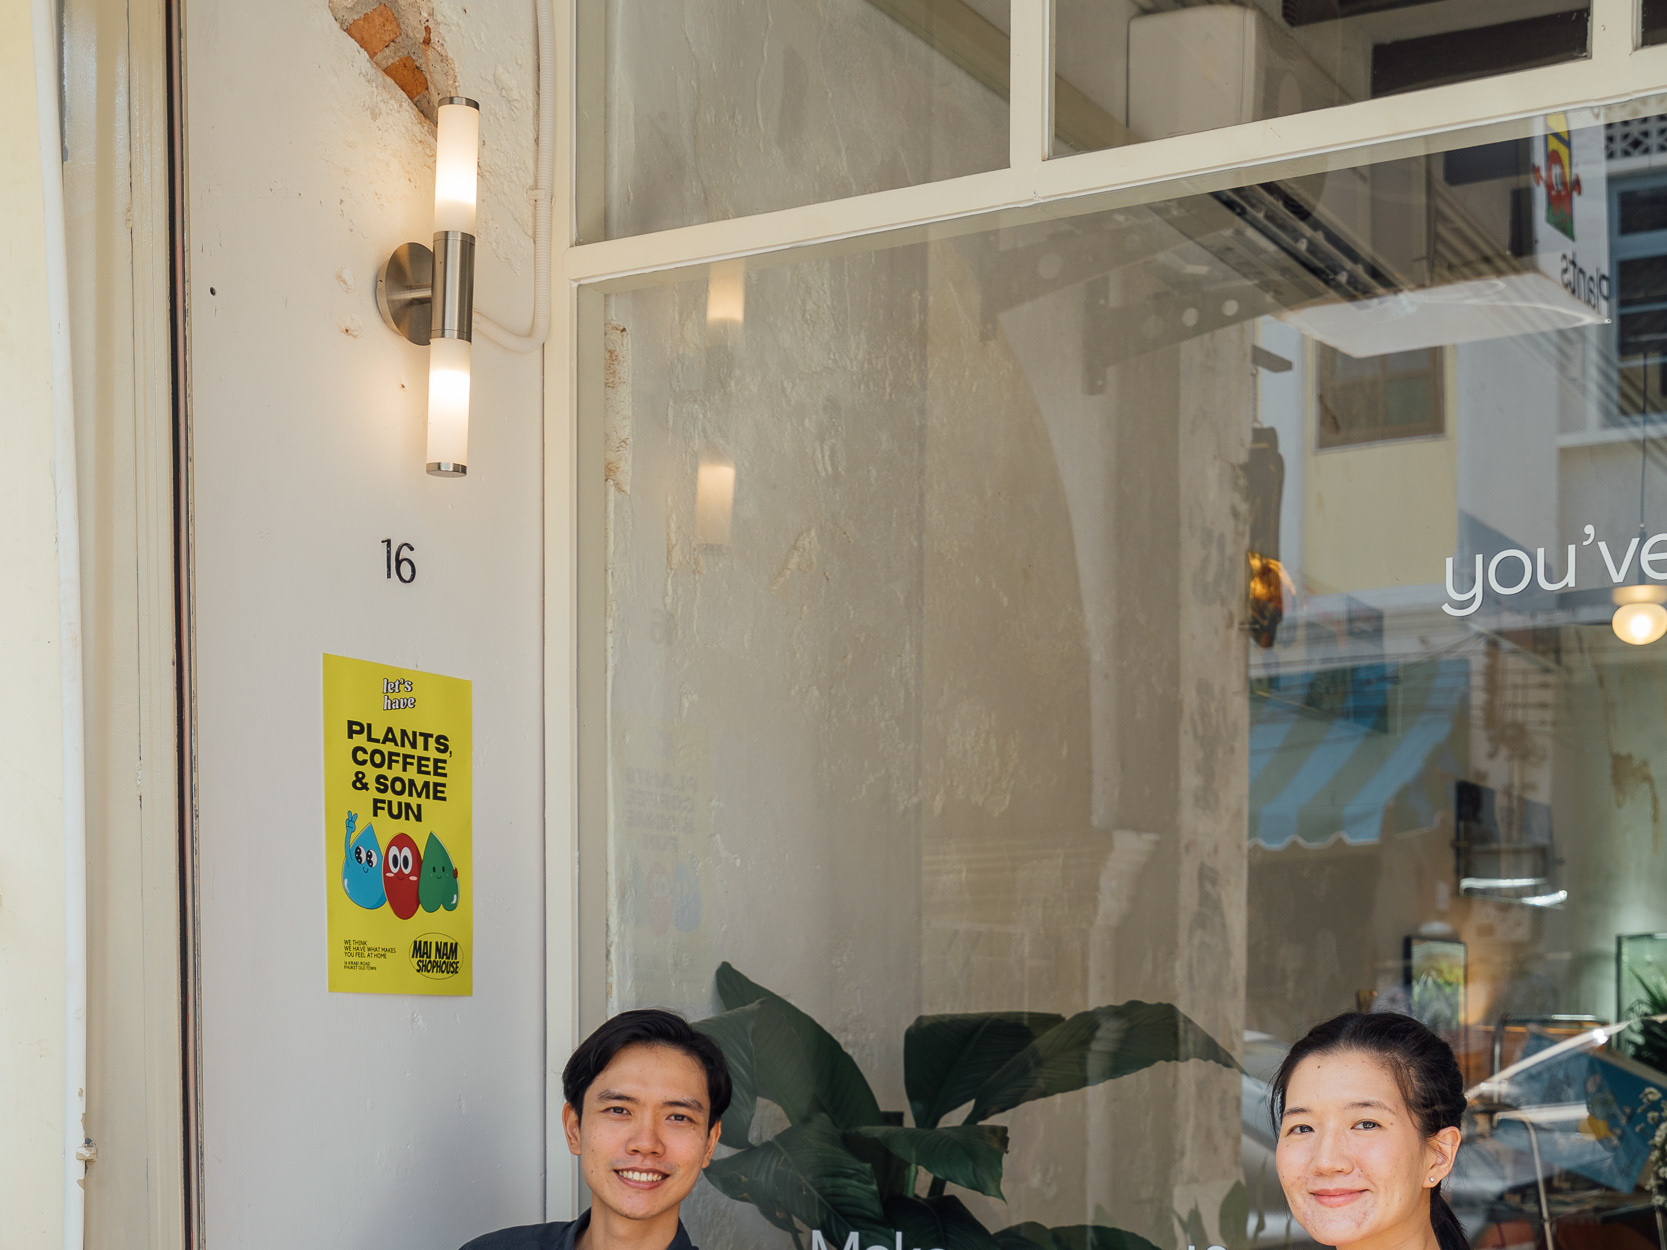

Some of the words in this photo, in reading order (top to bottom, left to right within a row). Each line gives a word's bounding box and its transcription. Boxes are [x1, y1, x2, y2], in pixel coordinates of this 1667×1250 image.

[381, 539, 416, 583] 16
[1441, 524, 1667, 617] you've
[382, 678, 413, 693] let's
[383, 695, 416, 711] have
[347, 720, 452, 758] PLANTS,
[351, 746, 448, 778] COFFEE
[351, 771, 370, 792] &
[374, 774, 447, 801] SOME
[372, 798, 423, 823] FUN
[412, 940, 432, 959] MAI
[435, 941, 458, 960] NAM
[416, 959, 460, 974] SHOPHOUSE
